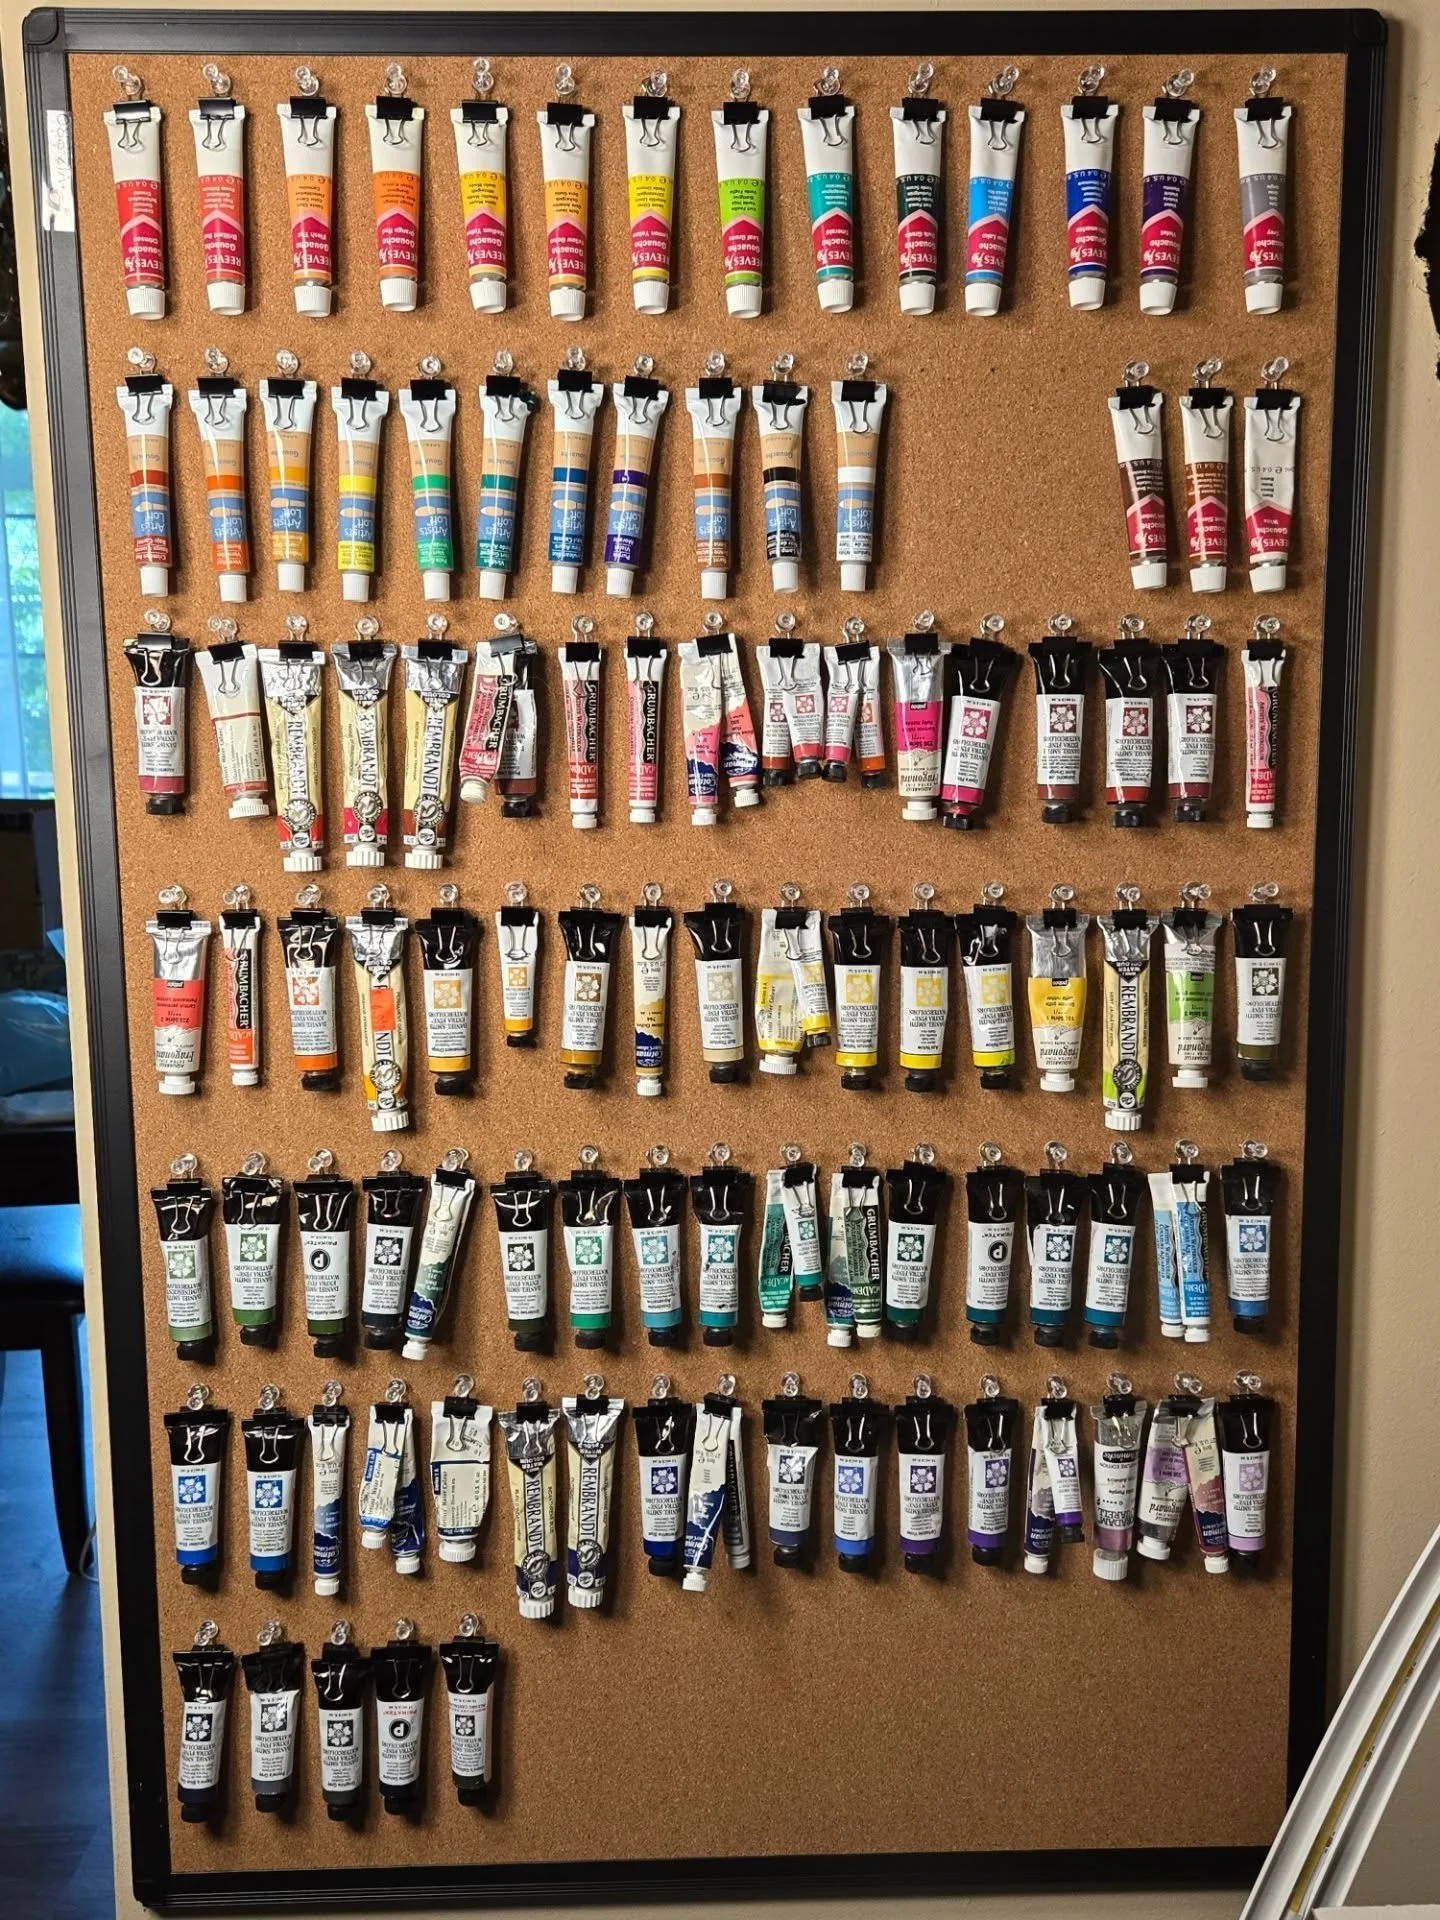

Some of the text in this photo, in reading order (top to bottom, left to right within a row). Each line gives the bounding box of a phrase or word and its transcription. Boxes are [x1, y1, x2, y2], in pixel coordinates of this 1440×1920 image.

[729, 234, 745, 242] Green
[1267, 229, 1279, 237] Grey
[382, 238, 415, 246] Gouache
[469, 238, 502, 246] Gouache
[635, 240, 667, 249] Gouache
[1075, 236, 1107, 245] Gouache
[296, 242, 329, 251] Gouache
[552, 246, 584, 256] Gouache
[728, 243, 760, 252] Gouache
[208, 255, 241, 266] REEVES
[733, 256, 760, 267] EEVES
[587, 685, 597, 760] GRUMBACHER
[647, 685, 657, 760] GRUMBACHER
[901, 772, 938, 785] Fragonard
[1121, 985, 1136, 1057] REMBRANDT
[1040, 1046, 1079, 1057] Fragonard
[867, 1208, 879, 1280] GRUMBACHER
[993, 1245, 1003, 1259] P
[315, 1254, 324, 1268] P
[581, 1468, 597, 1537] REMBRANDT
[527, 1479, 541, 1548] REMBRANDT
[394, 1723, 405, 1736] P
